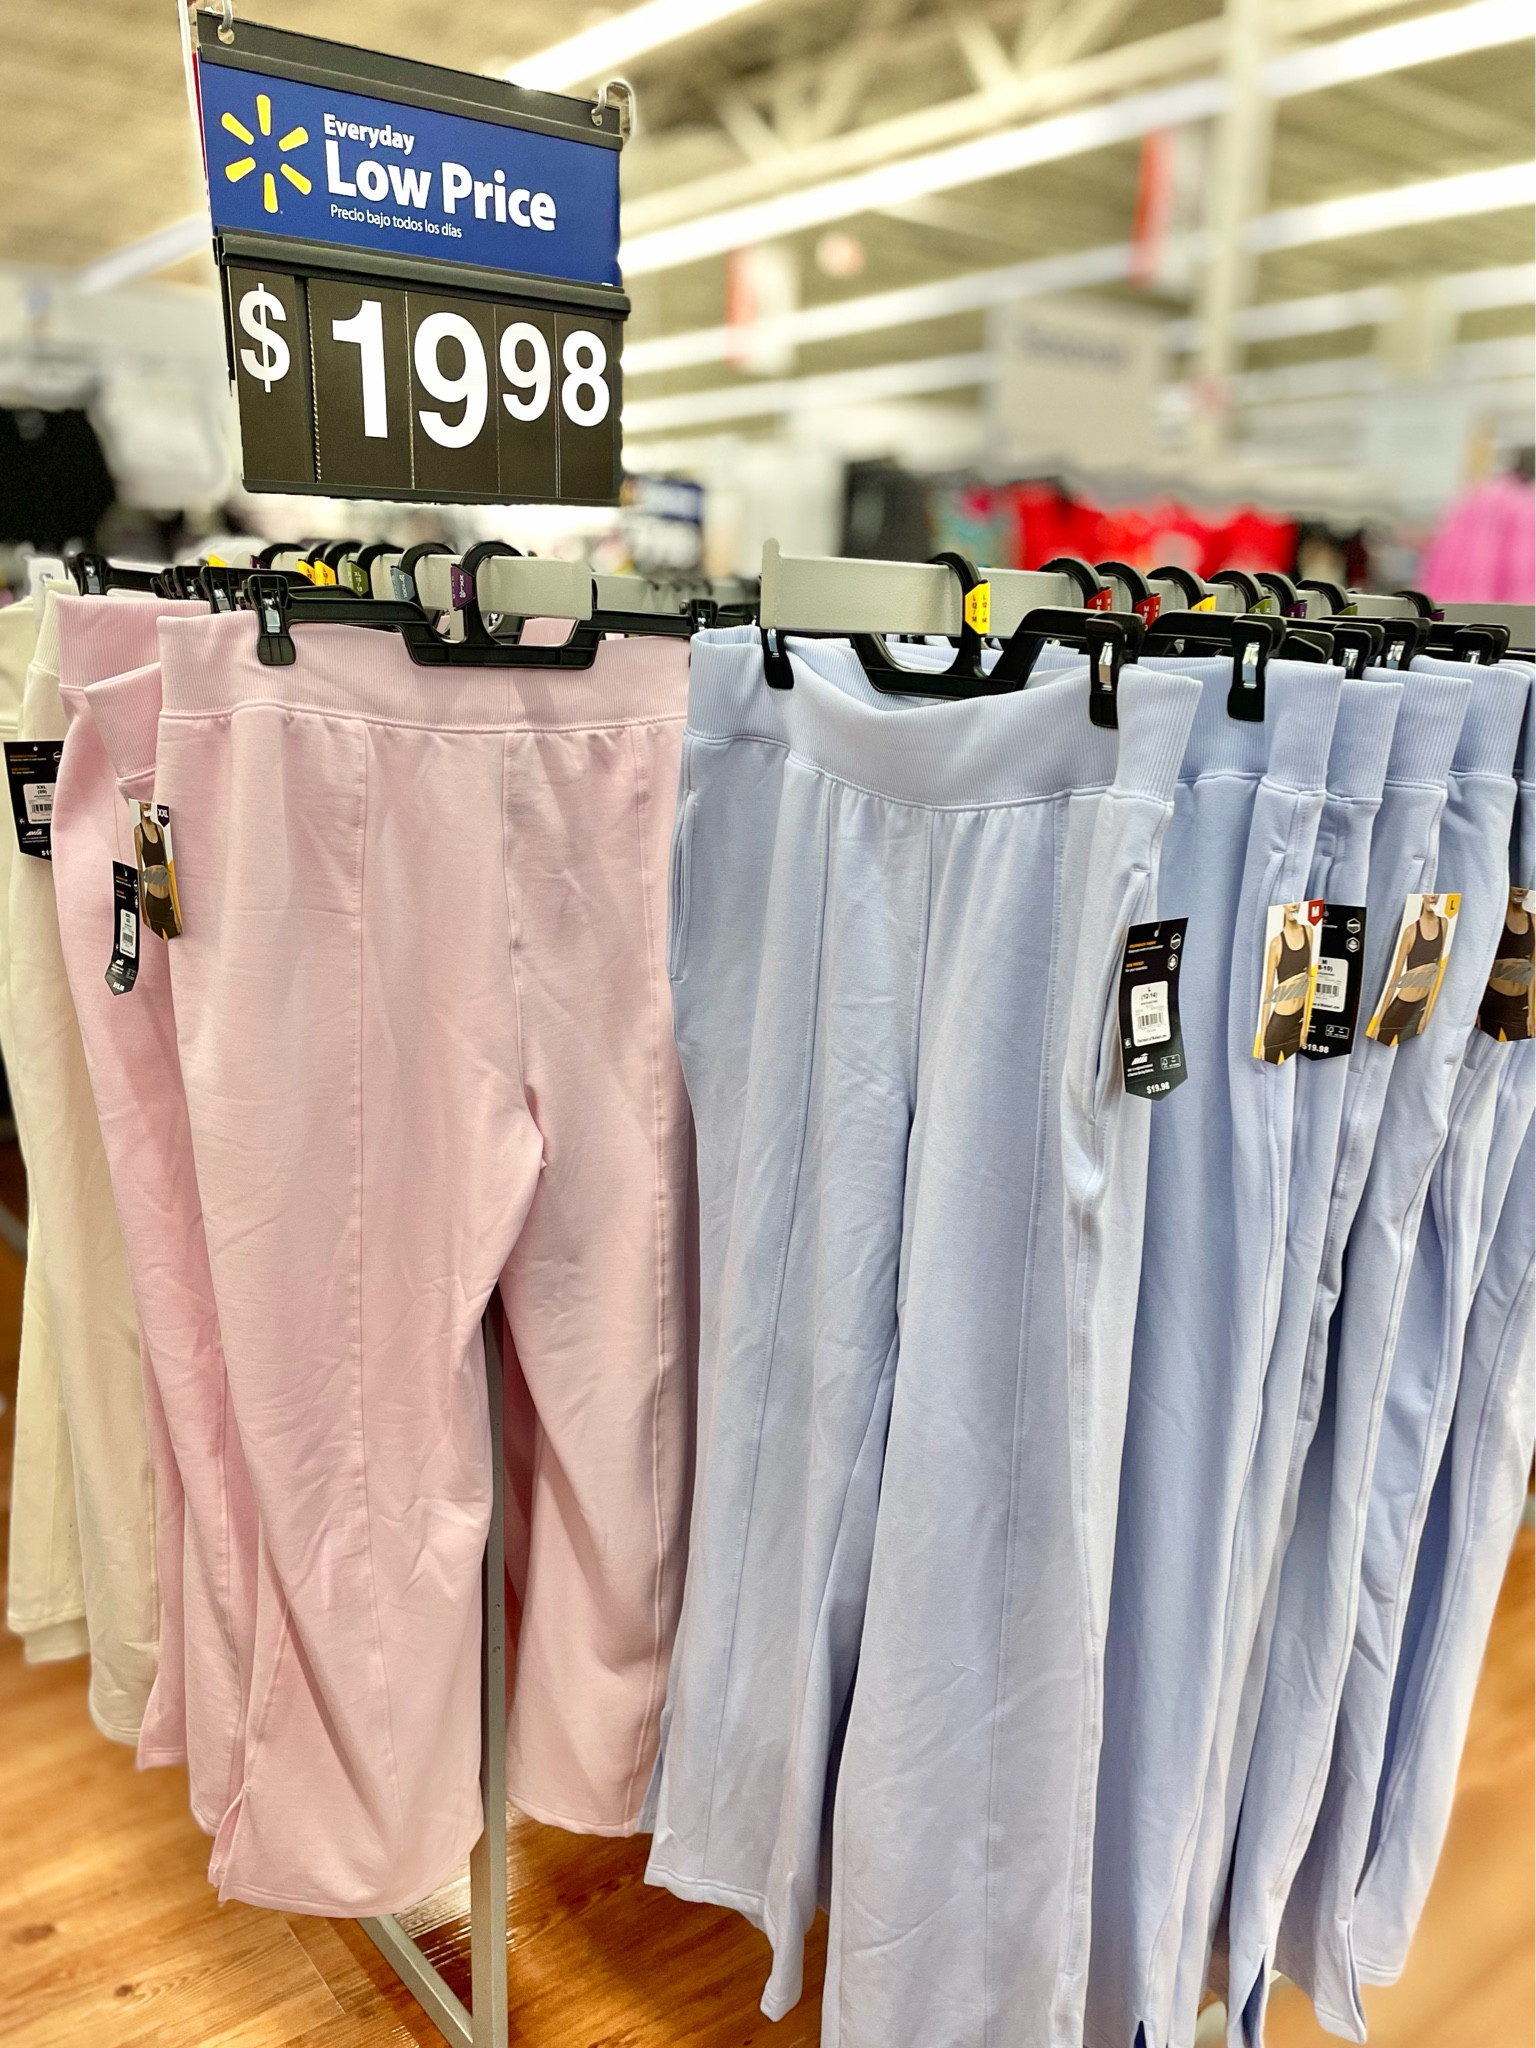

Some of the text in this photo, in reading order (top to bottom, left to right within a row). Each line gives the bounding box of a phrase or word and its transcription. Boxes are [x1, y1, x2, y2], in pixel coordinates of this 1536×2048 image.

[323, 113, 415, 155] Everyday
[325, 139, 557, 231] Low Price
[330, 203, 463, 239] Precio bajo todos los días
[1311, 905, 1320, 918] M
[1449, 900, 1455, 910] L
